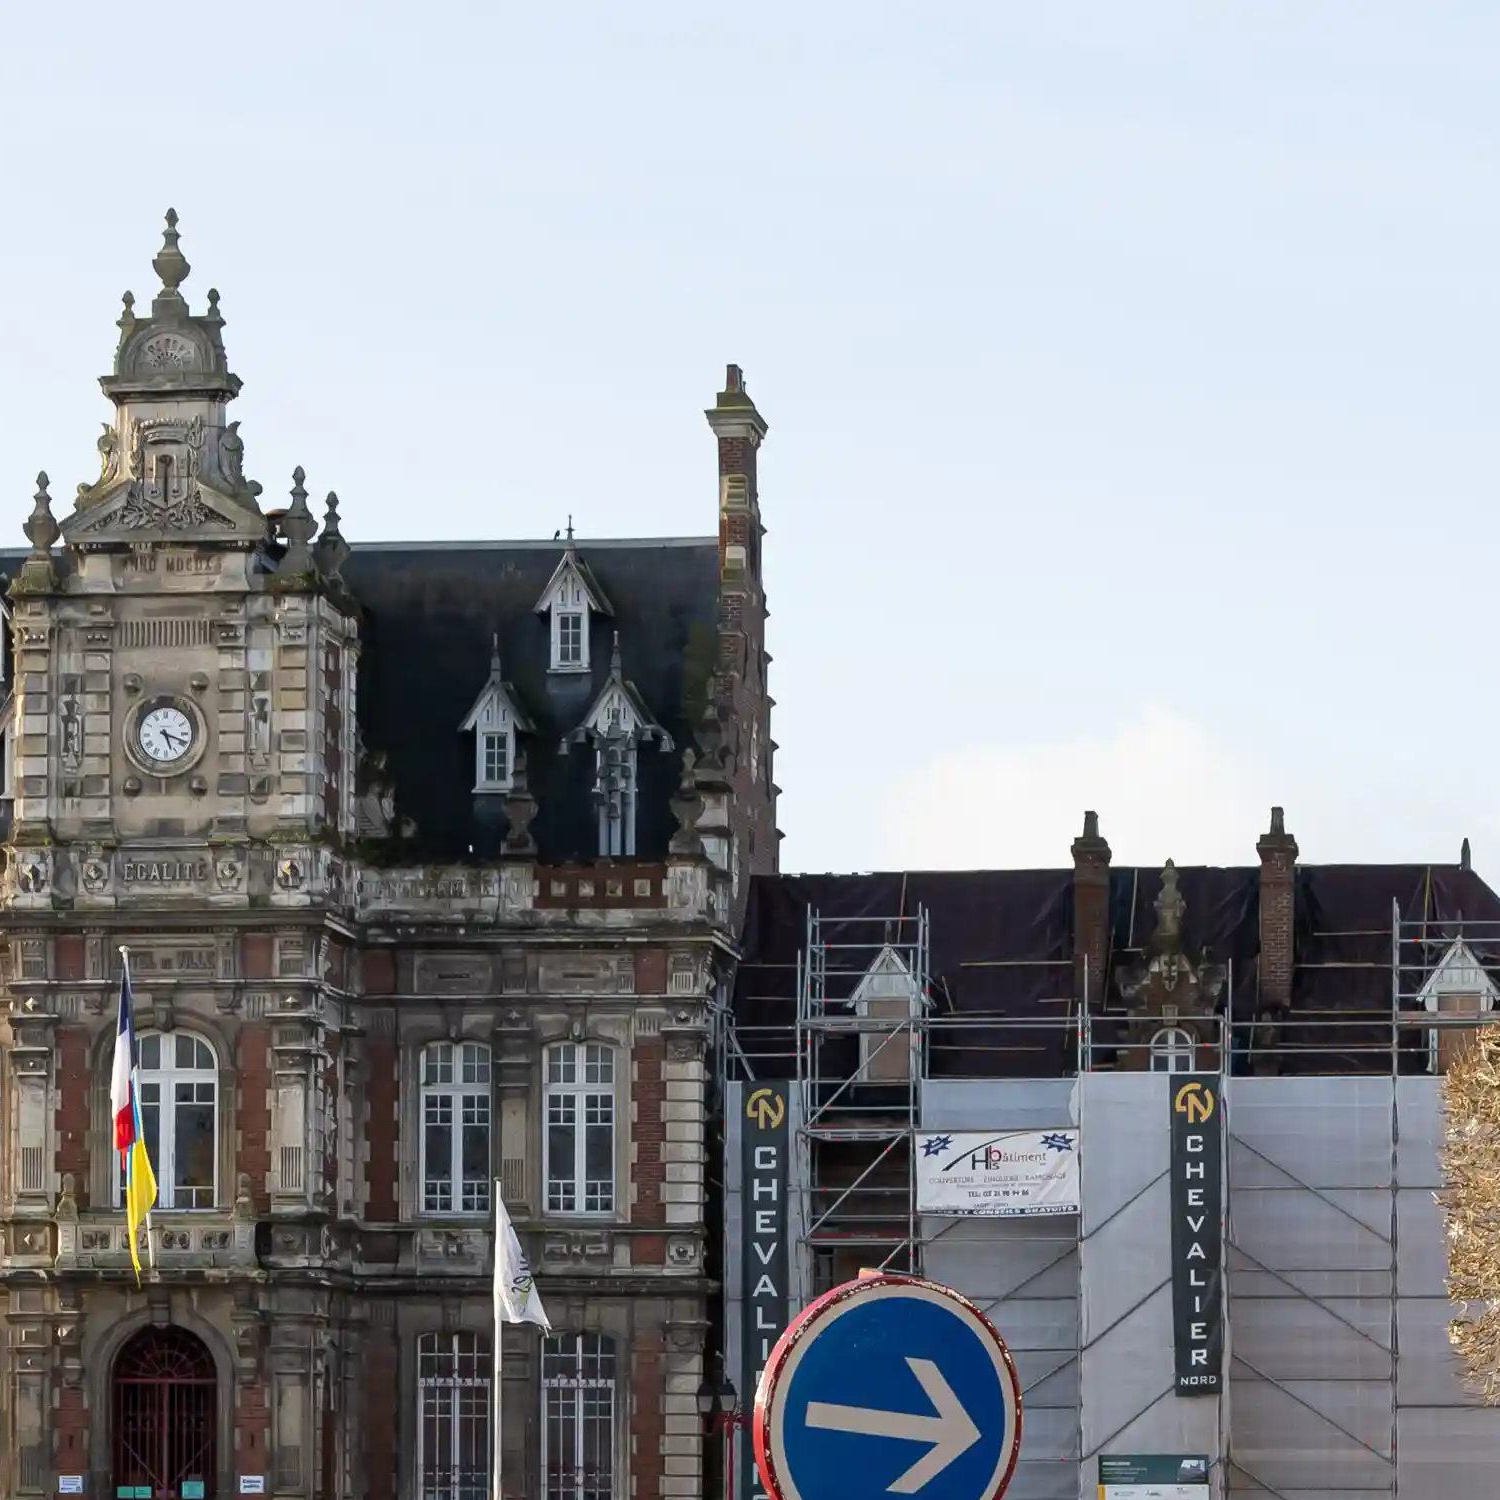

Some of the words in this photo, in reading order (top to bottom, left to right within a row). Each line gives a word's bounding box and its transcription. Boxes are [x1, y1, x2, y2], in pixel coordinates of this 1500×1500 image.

[752, 1146, 779, 1396] CHEVALI
[1185, 1134, 1208, 1366] CHEVALIER
[1180, 1375, 1217, 1387] NORD
